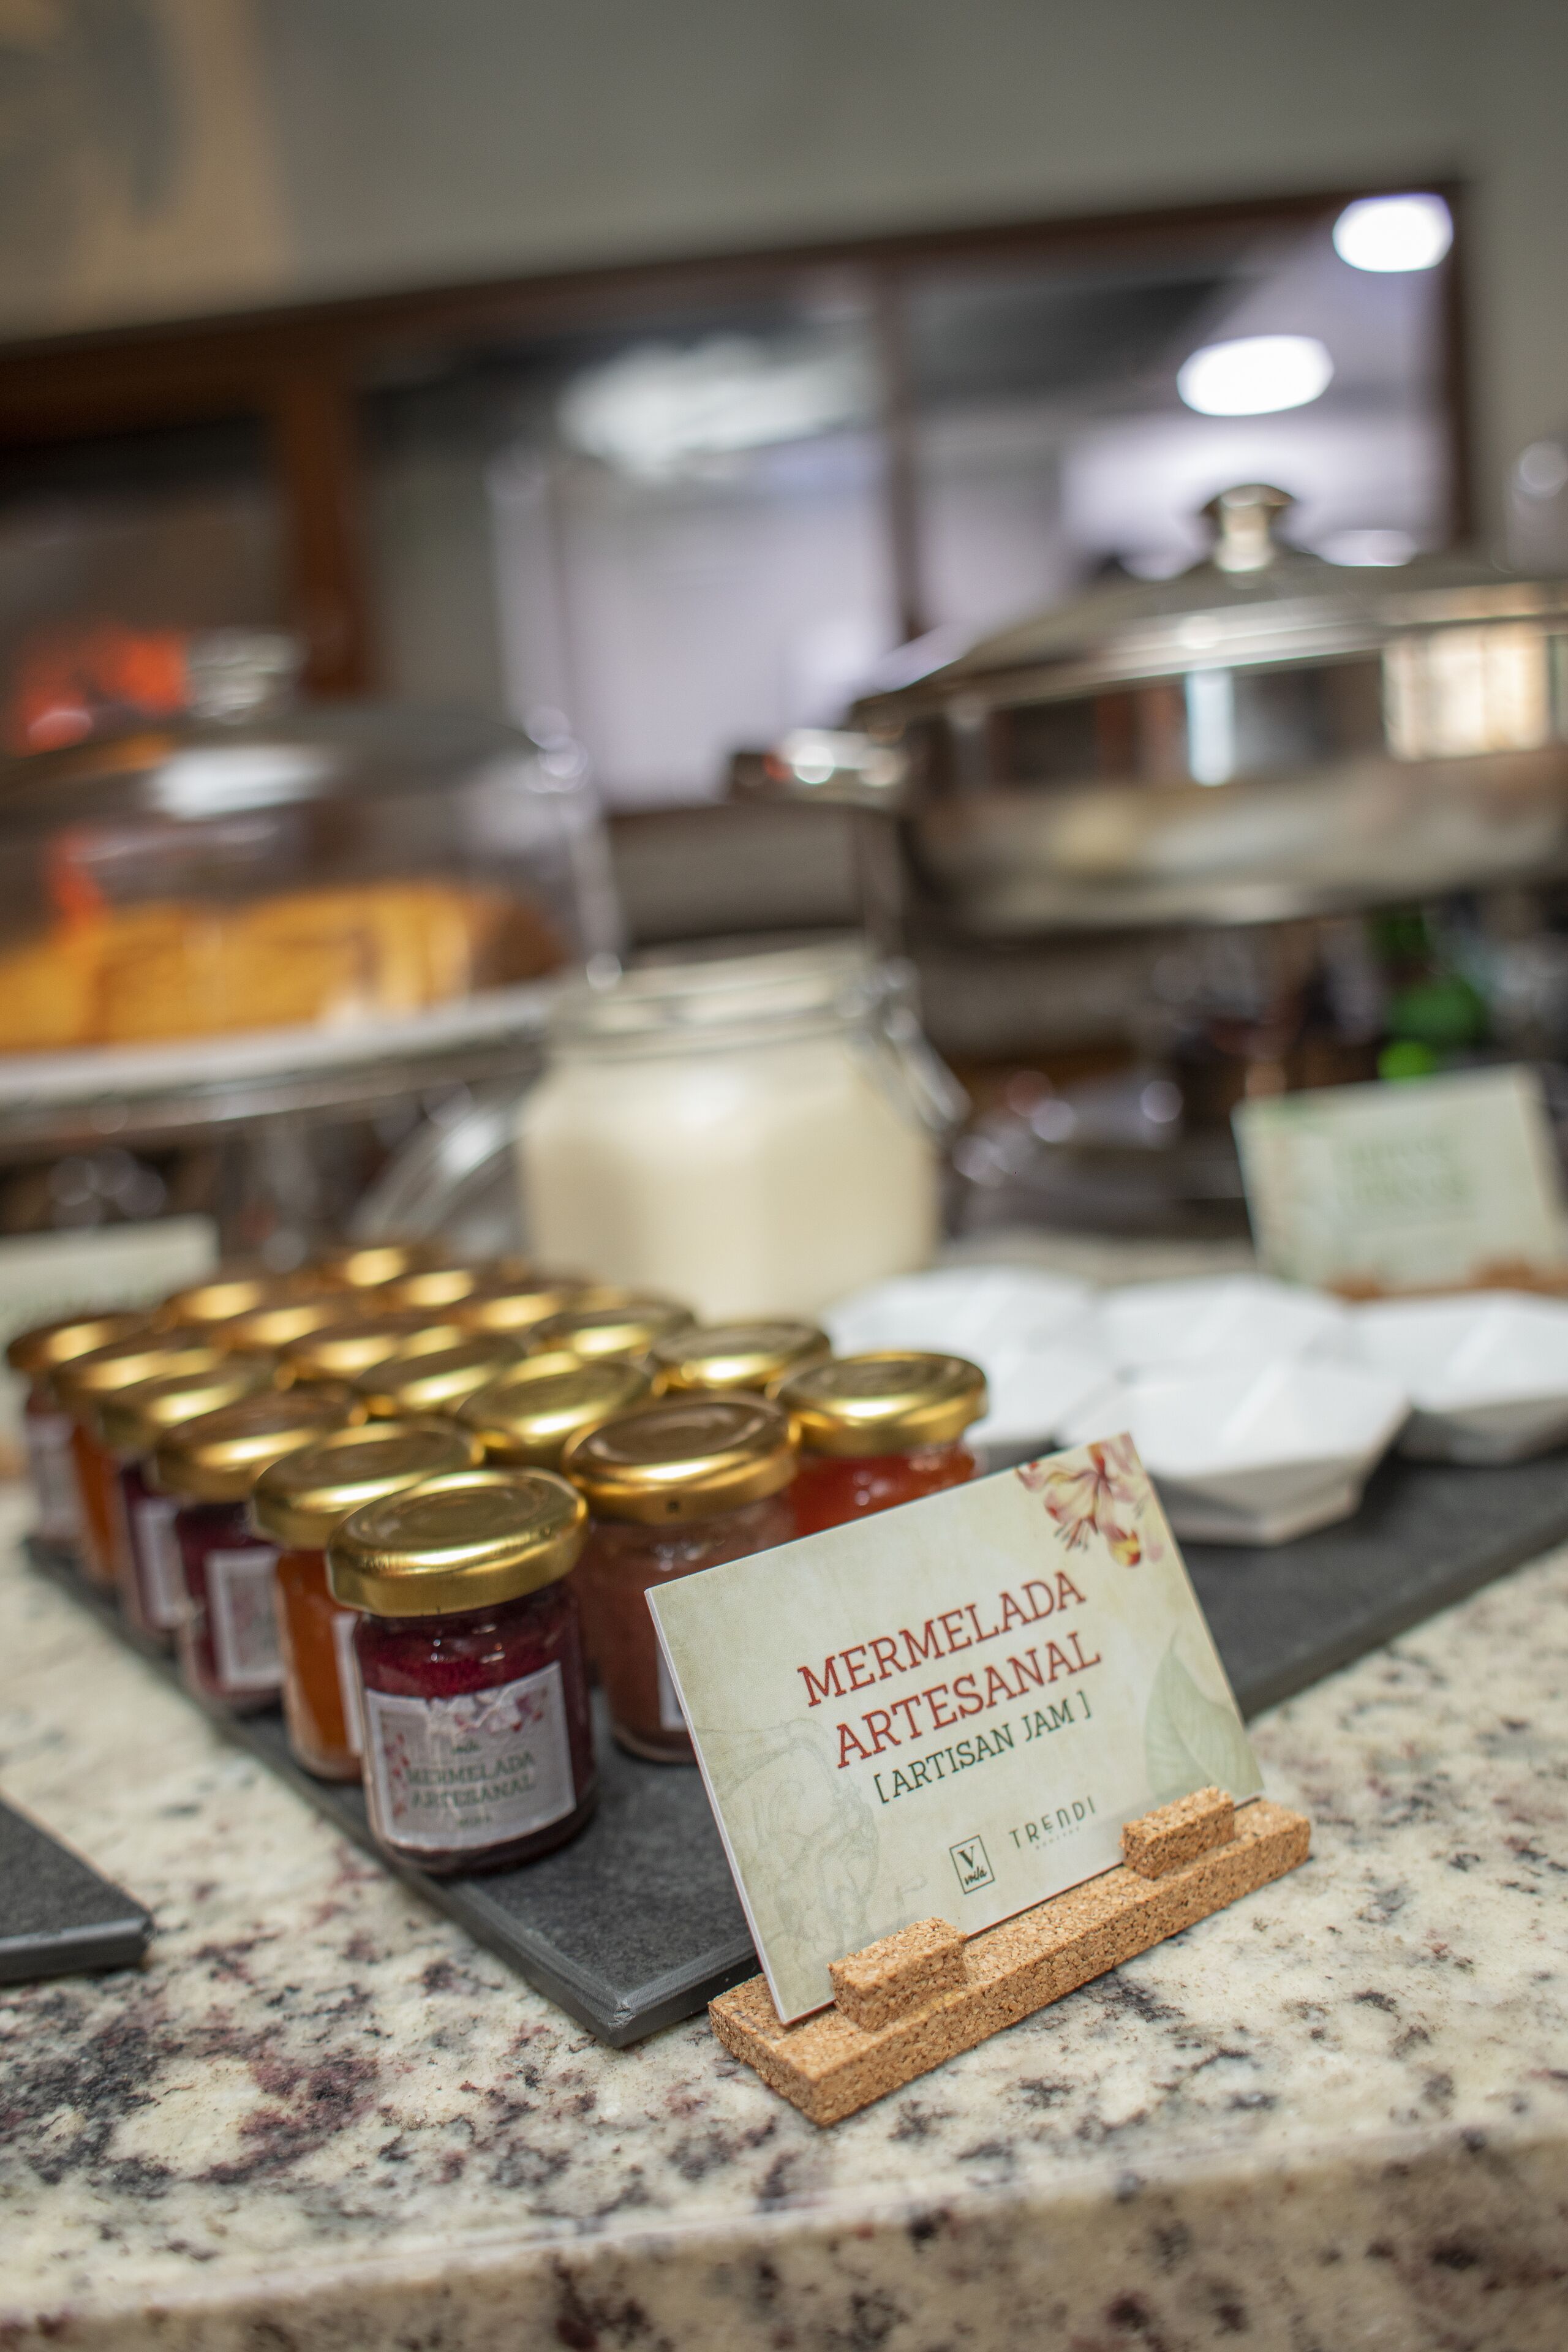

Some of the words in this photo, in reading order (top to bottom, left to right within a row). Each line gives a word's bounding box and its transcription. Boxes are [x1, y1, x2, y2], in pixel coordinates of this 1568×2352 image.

[797, 1571, 1086, 1707] MERMELADA
[837, 1632, 1101, 1768] ARTESANAL
[957, 1845, 975, 1868] V
